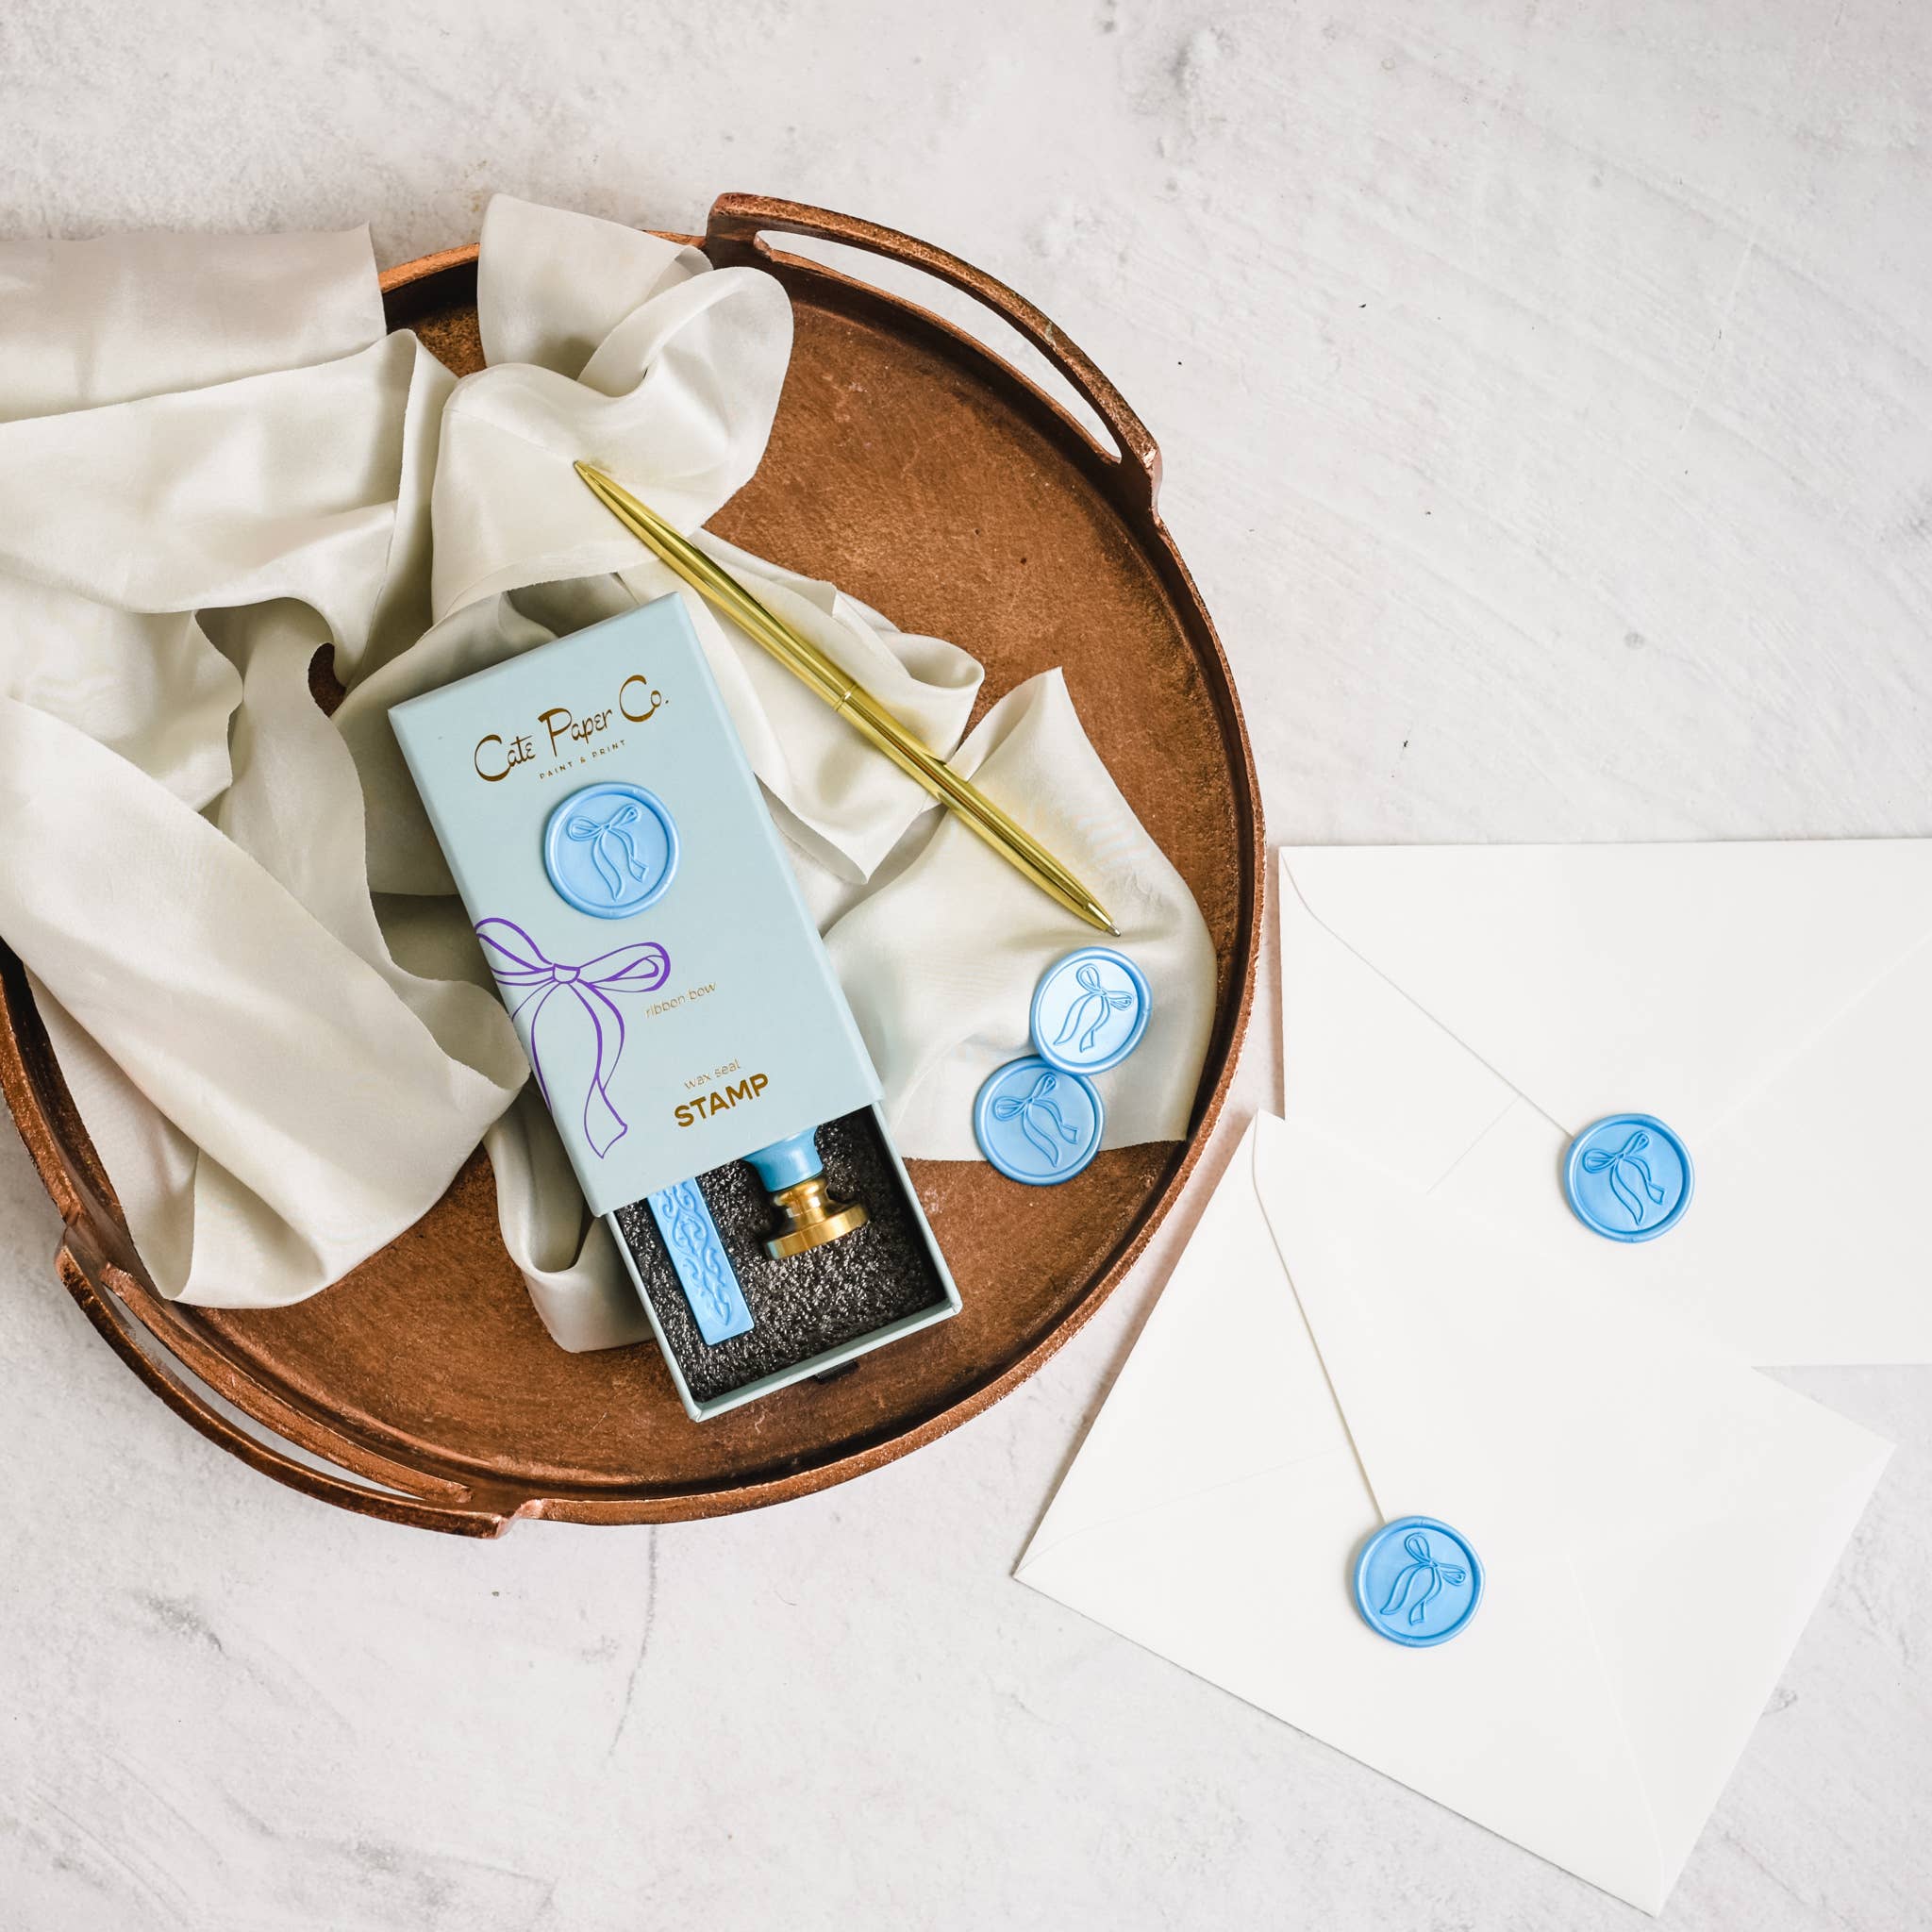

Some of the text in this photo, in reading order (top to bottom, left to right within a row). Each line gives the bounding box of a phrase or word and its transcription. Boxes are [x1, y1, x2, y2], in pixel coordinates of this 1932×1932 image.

[474, 675, 670, 782] Cate Paper Co.
[539, 761, 574, 779] PAINT
[591, 740, 626, 758] PRINT
[644, 982, 717, 1019] ribbon bow
[684, 1058, 741, 1090] wax seal
[674, 1073, 769, 1127] STAMP
